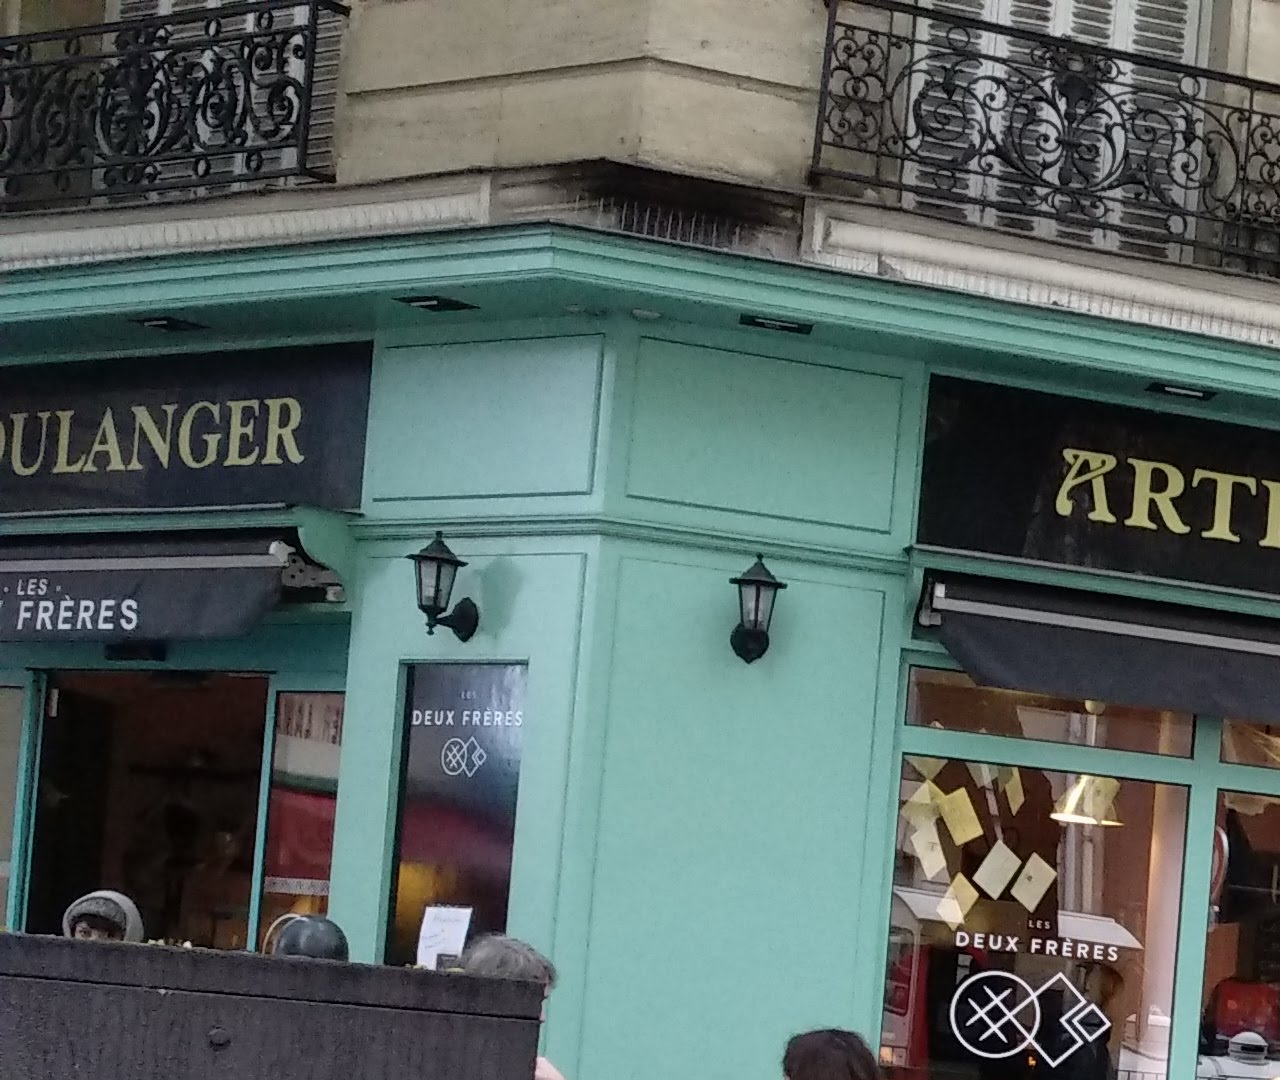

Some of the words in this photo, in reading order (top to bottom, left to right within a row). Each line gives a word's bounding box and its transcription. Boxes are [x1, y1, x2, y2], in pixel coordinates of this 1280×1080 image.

[0, 396, 305, 476] ULANGER
[16, 578, 49, 596] LES
[16, 594, 139, 631] FRÈRES
[461, 691, 477, 699] LES
[412, 710, 455, 726] DEUX
[462, 707, 524, 726] FRÈRES
[1028, 919, 1051, 930] LES
[955, 931, 1020, 952] DEUX
[1030, 938, 1119, 962] FRÈRES
